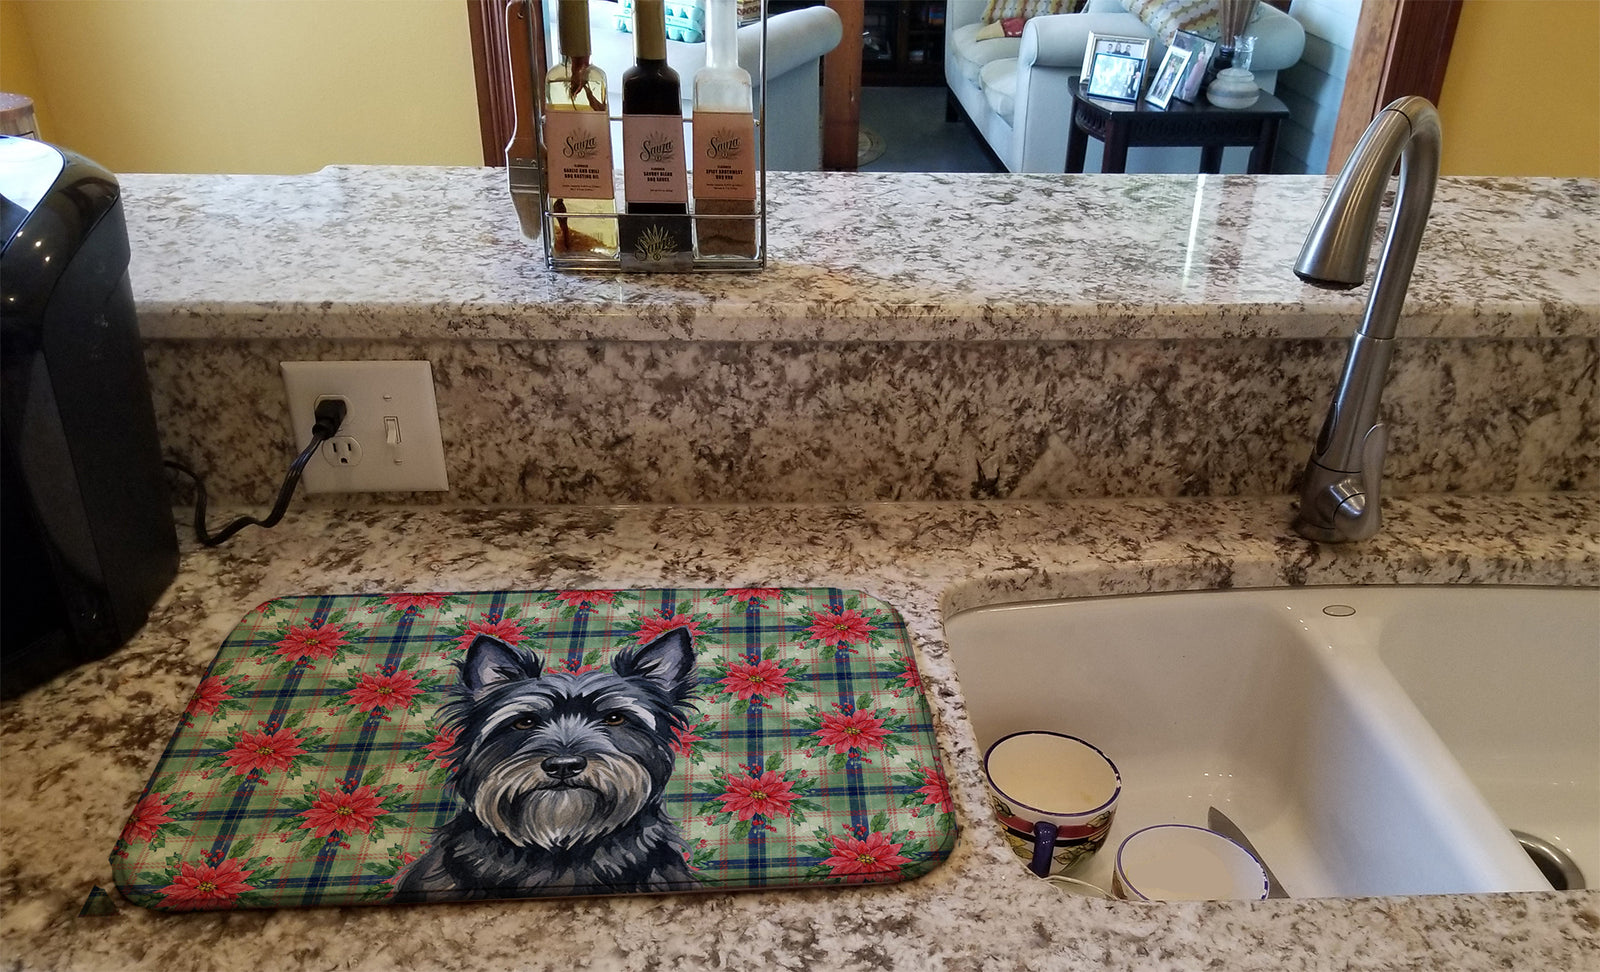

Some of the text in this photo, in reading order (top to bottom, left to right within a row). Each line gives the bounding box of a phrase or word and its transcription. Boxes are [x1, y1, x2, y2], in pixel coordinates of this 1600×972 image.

[563, 136, 596, 158] Sauza
[640, 140, 673, 161] Sauza
[707, 137, 739, 158] Sauza
